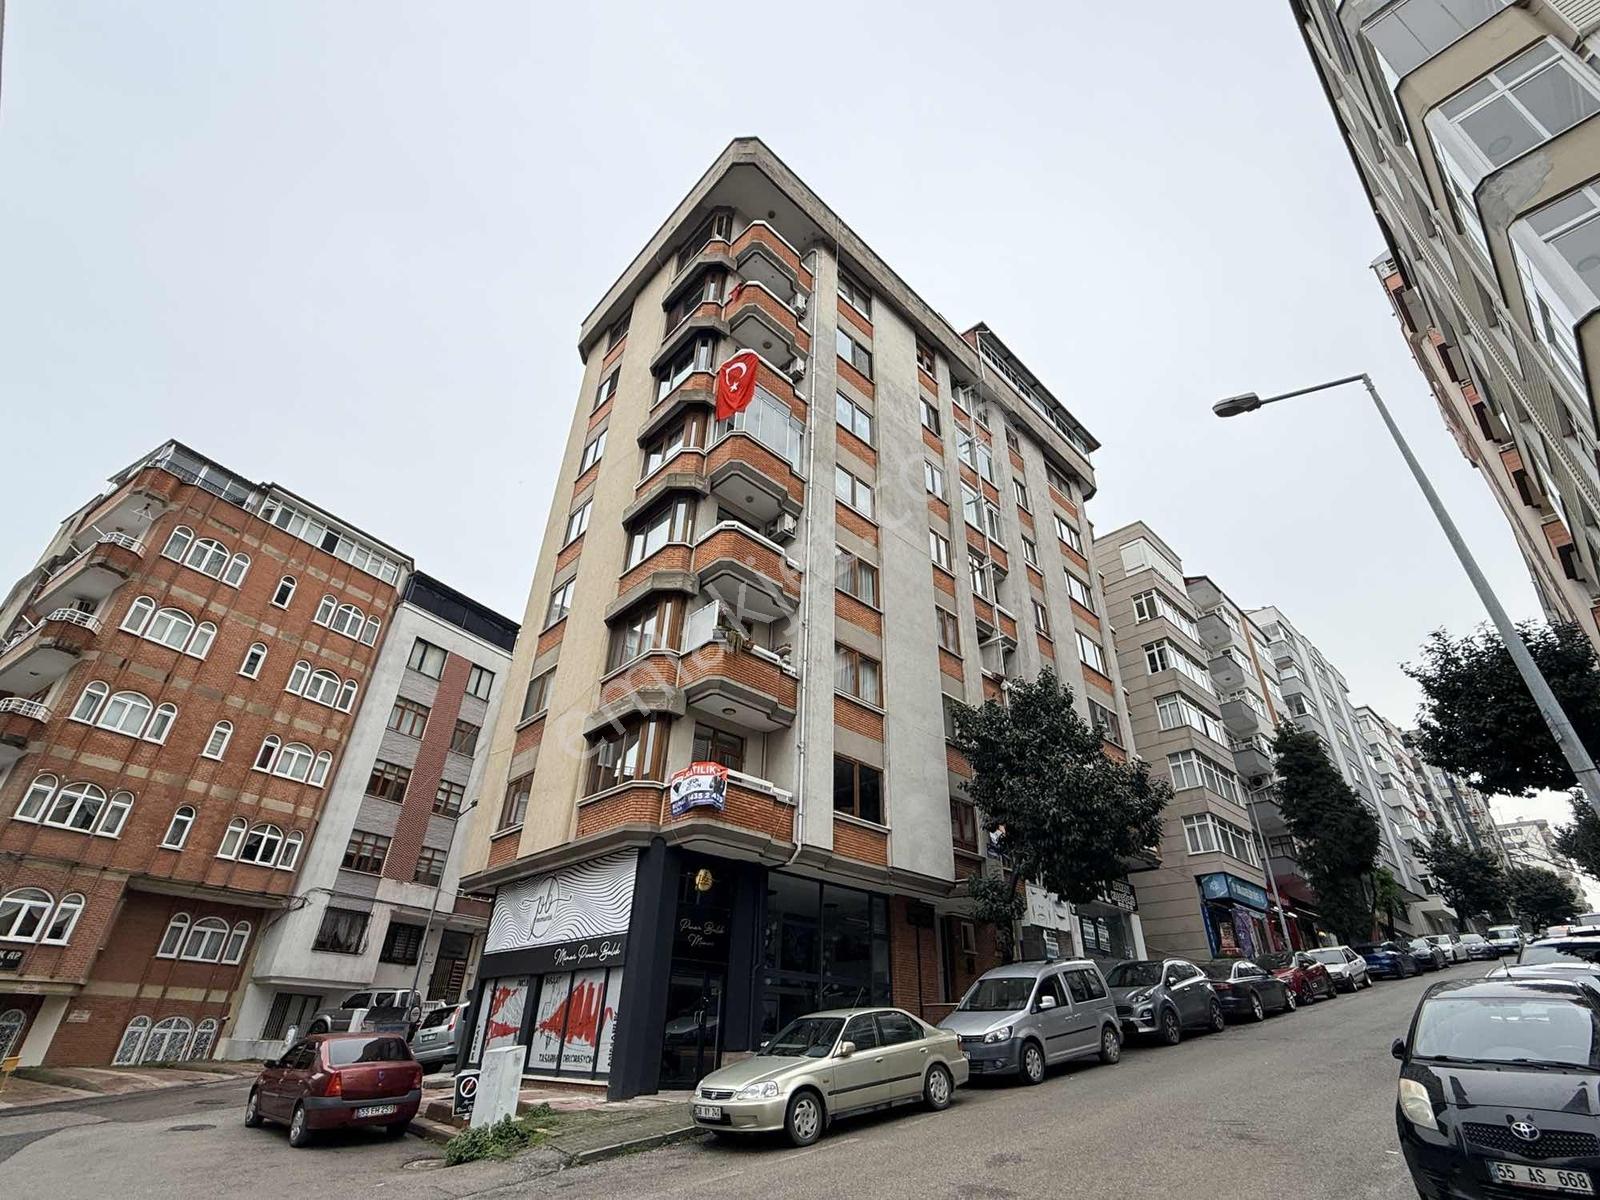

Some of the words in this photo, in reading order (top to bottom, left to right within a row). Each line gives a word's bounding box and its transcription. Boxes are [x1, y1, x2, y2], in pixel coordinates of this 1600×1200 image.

[1496, 1163, 1516, 1180] 55
[1527, 1167, 1546, 1183] AS
[1556, 1171, 1588, 1189] 668
